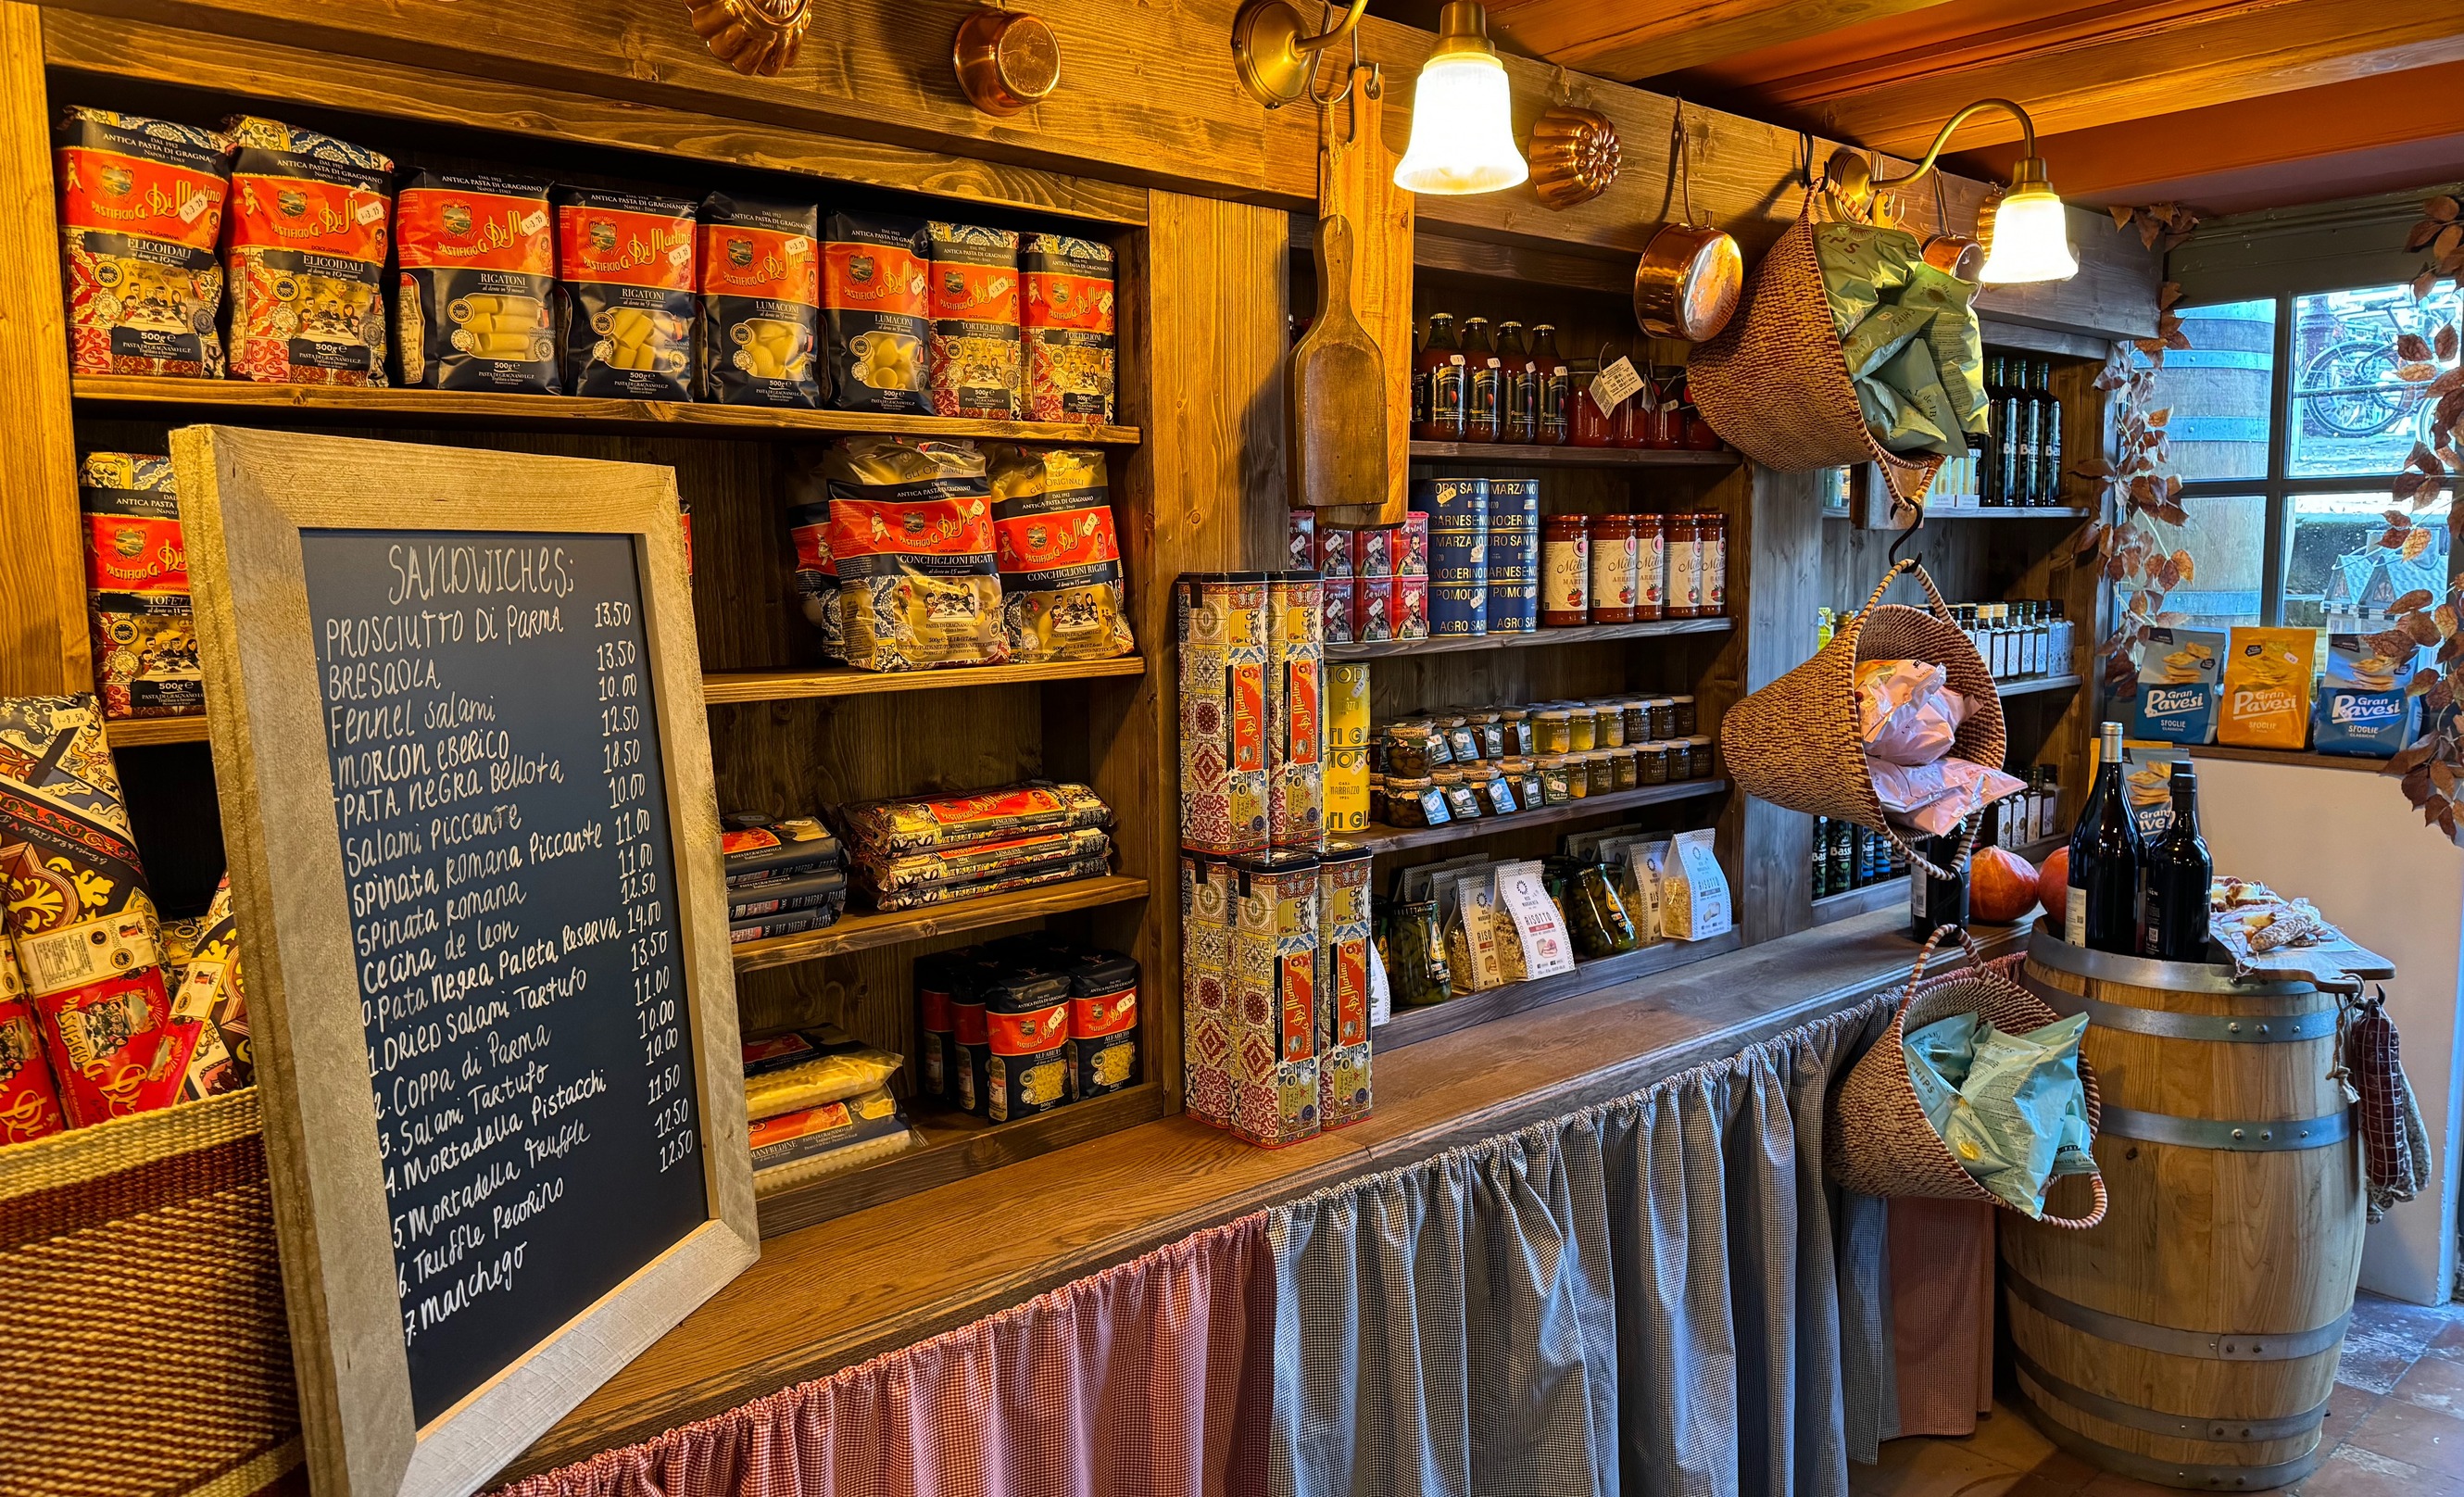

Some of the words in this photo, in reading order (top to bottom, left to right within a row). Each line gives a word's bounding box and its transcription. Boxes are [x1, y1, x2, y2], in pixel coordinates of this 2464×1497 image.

[103, 132, 136, 146] ANTICA
[138, 139, 163, 154] PASTA
[163, 145, 174, 155] DI
[277, 159, 308, 172] ANTICA
[308, 163, 331, 176] PASTA
[331, 169, 342, 177] DI
[342, 170, 383, 185] GRAGNANO
[591, 194, 618, 204] ANTICA
[618, 197, 638, 206] PASTA
[648, 201, 686, 211] GRAGNANO
[271, 221, 310, 240] PASTIFICIO
[127, 237, 192, 260] ELICOIDALI
[437, 241, 479, 258] PASTIFICIO
[303, 254, 364, 273] ELICOIDALI
[583, 255, 622, 273] PASTIFICIO
[481, 272, 526, 287] RIGATONI
[622, 287, 665, 301] RIGATONI
[756, 300, 800, 314] LUMACONI
[874, 314, 914, 327] LUMACONI
[961, 321, 1005, 333] TORTIGLIONI
[1460, 482, 1480, 495] SAN
[1490, 484, 1537, 496] MARZANO
[117, 497, 149, 508] ANTICA
[150, 499, 175, 509] PASTA
[1489, 515, 1536, 527] NOCERINO
[1437, 535, 1484, 547] MARZANO
[899, 554, 971, 565] CONCHIGLIONI
[971, 553, 995, 564] RIGATI
[1027, 565, 1087, 583] CONCHIGLIONI
[1435, 567, 1483, 580] NOCERINO
[326, 610, 465, 662] PROSCIUTTO
[595, 601, 632, 628] 13.50
[1440, 620, 1468, 632] AGRO
[1497, 617, 1524, 629] AGRO
[597, 640, 636, 672] 13.50
[2168, 689, 2194, 699] Gran
[2233, 691, 2297, 715] Pavesi
[2256, 690, 2284, 699] Gran
[2357, 697, 2389, 706] Gran
[330, 698, 416, 748] Fennel
[599, 673, 637, 702] 10.00
[601, 705, 640, 737] 12.50
[2160, 719, 2186, 728] SFOGLIE
[2348, 724, 2379, 735] SFOGLIE
[602, 738, 641, 774] 18.50
[2139, 808, 2169, 820] Gran
[346, 823, 423, 879] Salami
[609, 773, 646, 809] 10.00
[615, 808, 650, 846] 11.00
[618, 843, 653, 880] 11.00
[445, 929, 468, 962] de
[621, 873, 656, 905] 12.50
[626, 899, 661, 935] 14.00
[1525, 912, 1553, 926] RISOTTO
[630, 929, 669, 973] 13.50
[461, 1045, 483, 1082] di
[634, 965, 671, 1008] 11.00
[400, 1096, 464, 1157] Salami
[637, 999, 675, 1040] 10.00
[1906, 1060, 1936, 1095] CHIPS
[403, 1112, 524, 1191] Mortadella
[531, 1068, 608, 1126] Pistacchi
[646, 1026, 679, 1066] 10.00
[654, 1097, 689, 1139] 12.50
[408, 1161, 522, 1243] Mortadella
[647, 1063, 681, 1105] 11.50
[659, 1128, 694, 1175] 12.50
